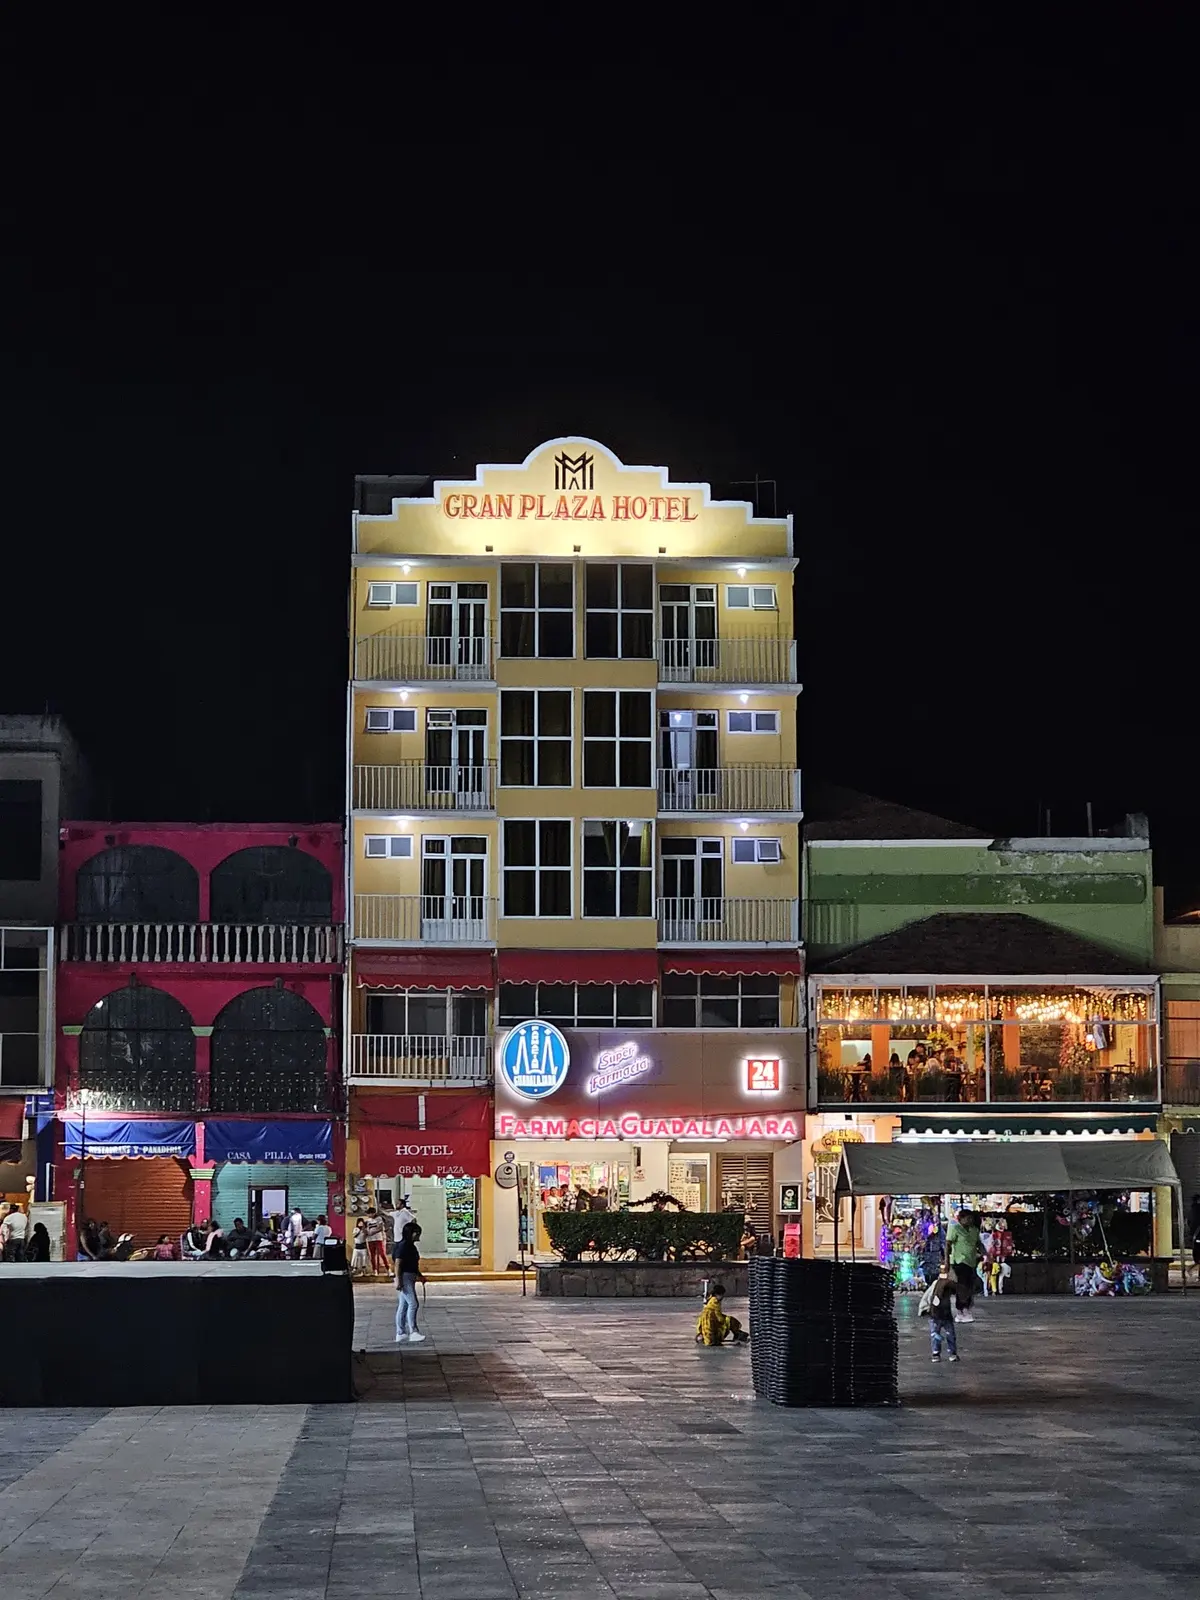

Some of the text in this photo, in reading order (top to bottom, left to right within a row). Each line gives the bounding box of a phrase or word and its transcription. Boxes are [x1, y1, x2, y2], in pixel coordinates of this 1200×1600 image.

[444, 494, 698, 522] GRAN PLAZA HOTEL
[599, 1047, 635, 1069] Super
[591, 1058, 650, 1091] Farmacia
[752, 1061, 775, 1081] 24
[500, 1115, 797, 1136] FARMACIA GUADALAJARA
[227, 1151, 251, 1160] CASA
[264, 1151, 293, 1160] PILLA
[395, 1145, 453, 1156] HOTEL
[398, 1165, 465, 1174] GRAN PLAZA
